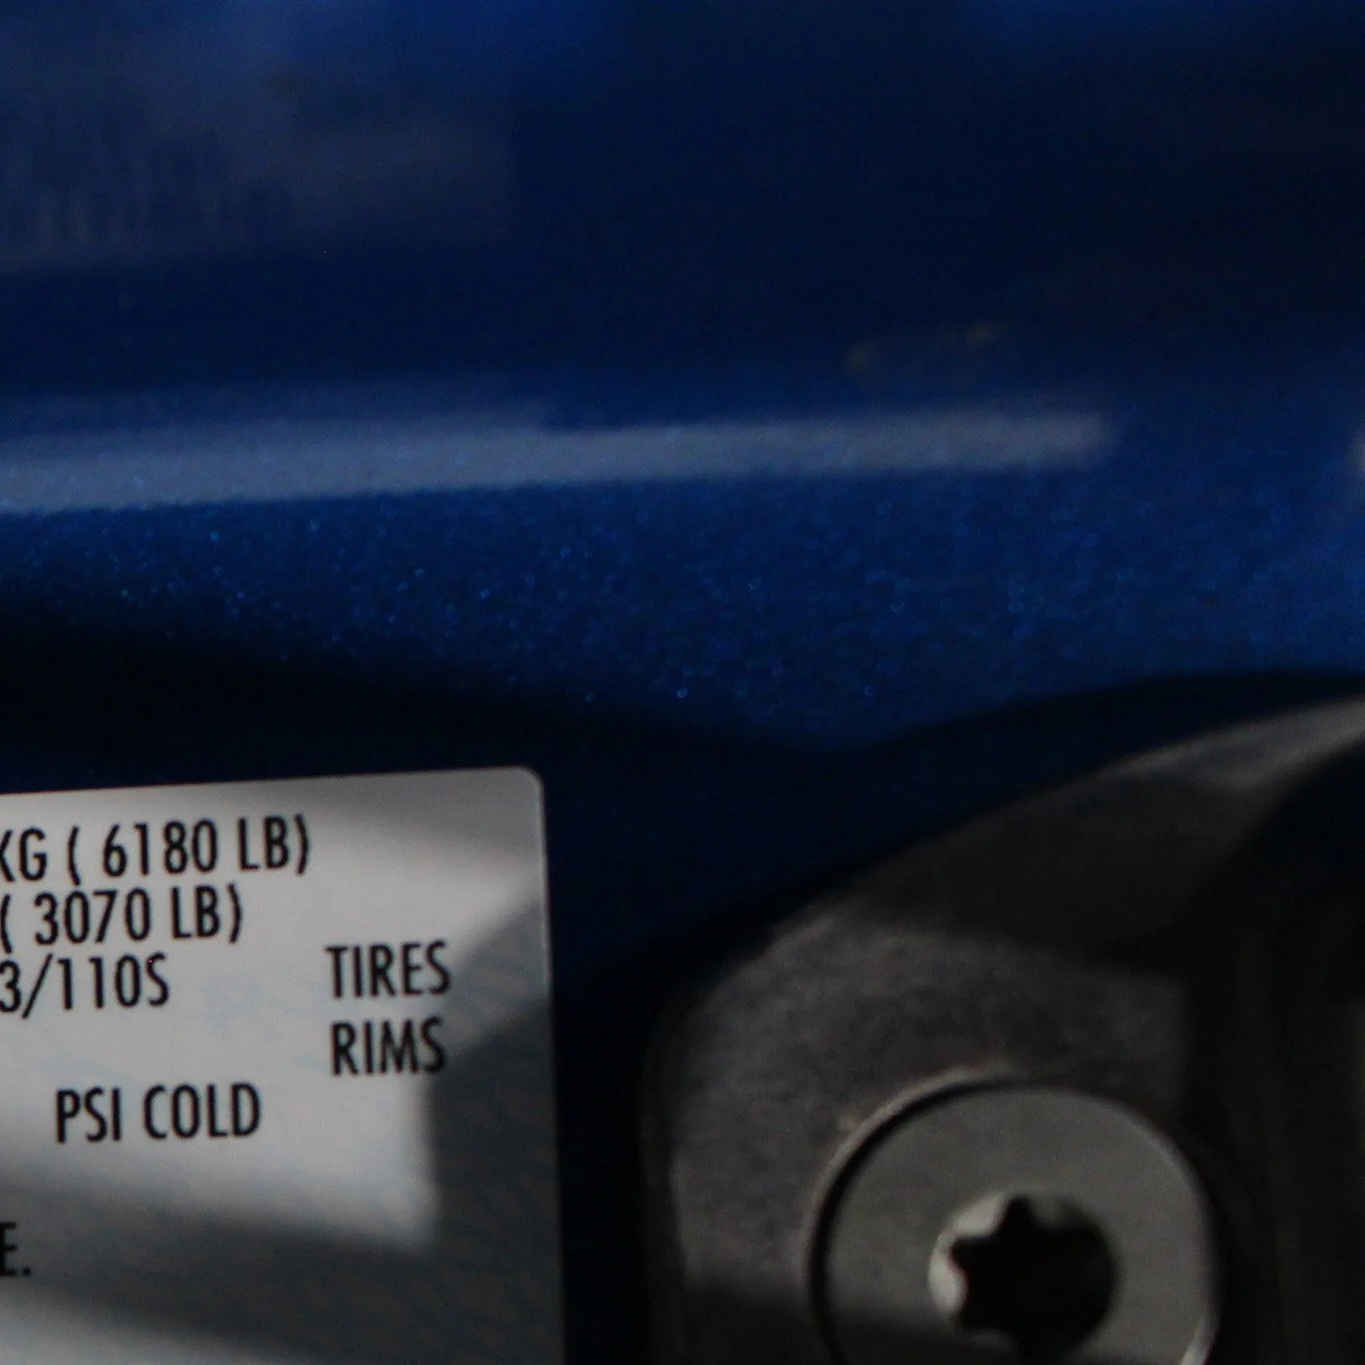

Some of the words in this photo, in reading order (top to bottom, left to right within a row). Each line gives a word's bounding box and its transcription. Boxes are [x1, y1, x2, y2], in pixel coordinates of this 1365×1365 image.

[103, 819, 218, 877] 6180
[238, 814, 309, 874] LB)
[34, 888, 151, 945] 3070
[171, 884, 242, 943] LB)
[326, 940, 451, 998] TIRES
[332, 1017, 447, 1075] RIMS
[56, 1087, 121, 1143] PSI
[144, 1083, 260, 1140] COLD
